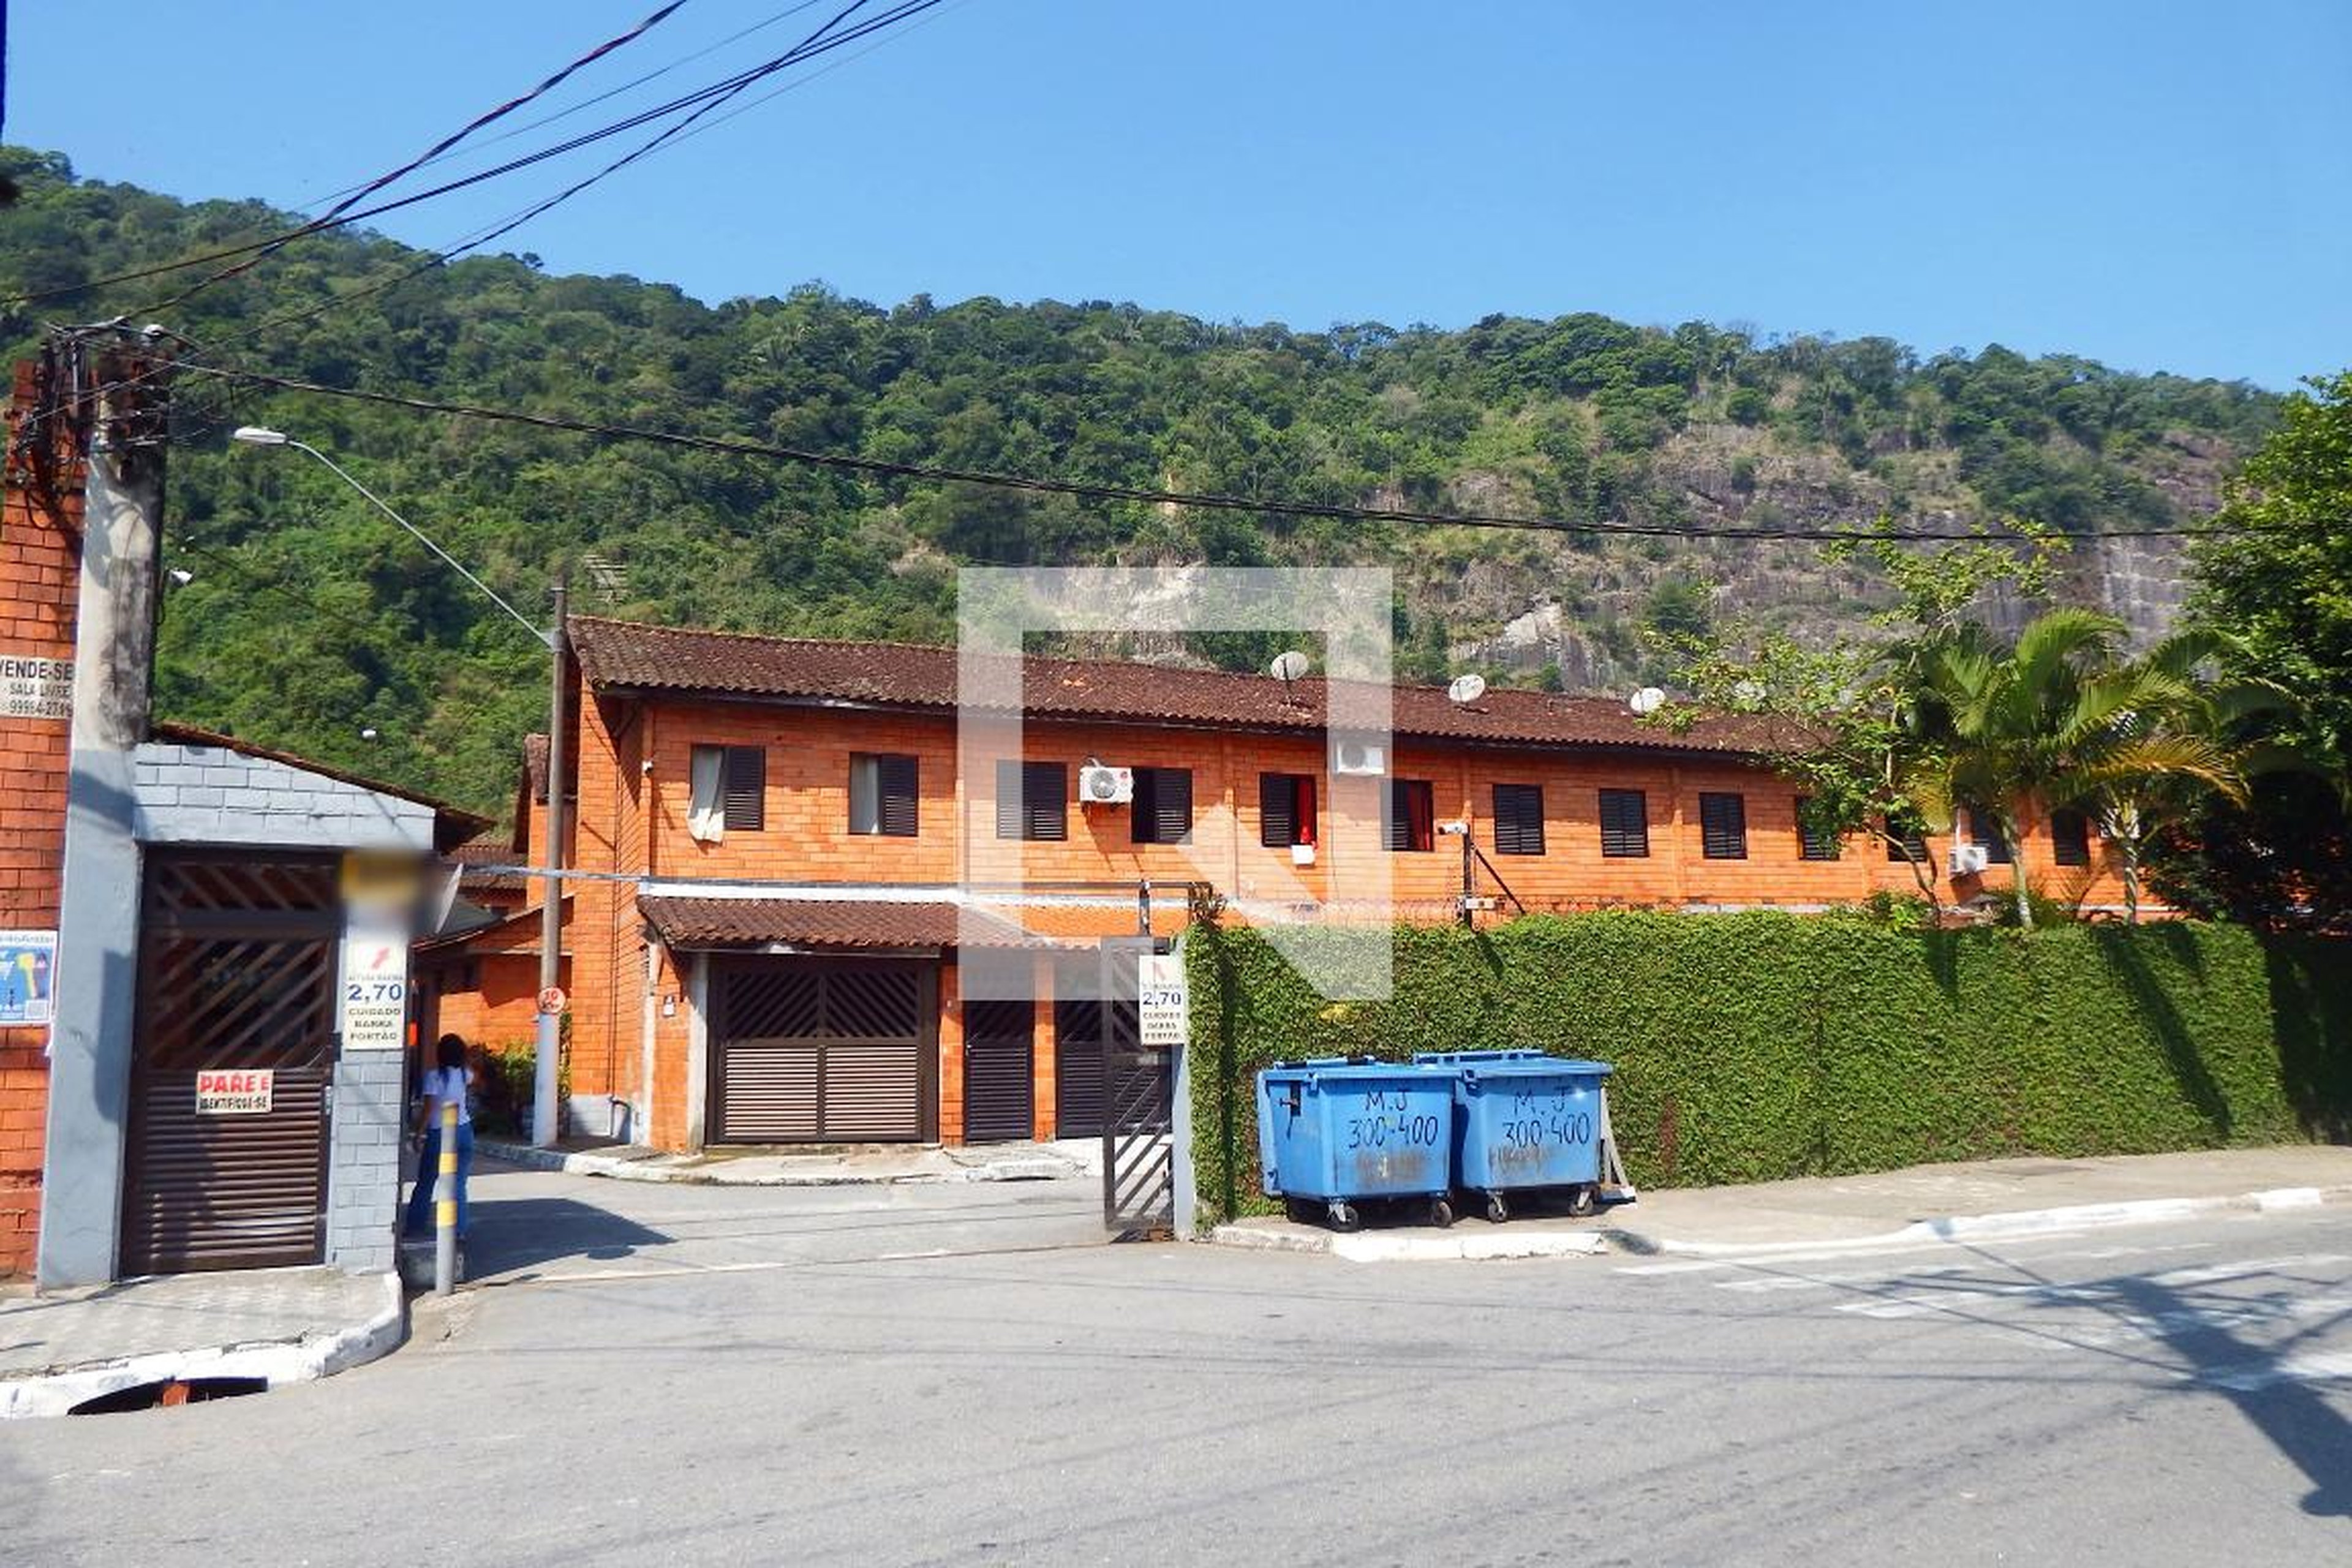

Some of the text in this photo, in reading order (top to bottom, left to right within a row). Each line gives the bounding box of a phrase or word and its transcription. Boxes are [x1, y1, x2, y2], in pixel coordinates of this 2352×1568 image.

[348, 984, 402, 1003] 2,70
[1143, 992, 1182, 1009] 2,70
[348, 1008, 402, 1016] CUIDADO
[200, 1074, 270, 1093] PARE E
